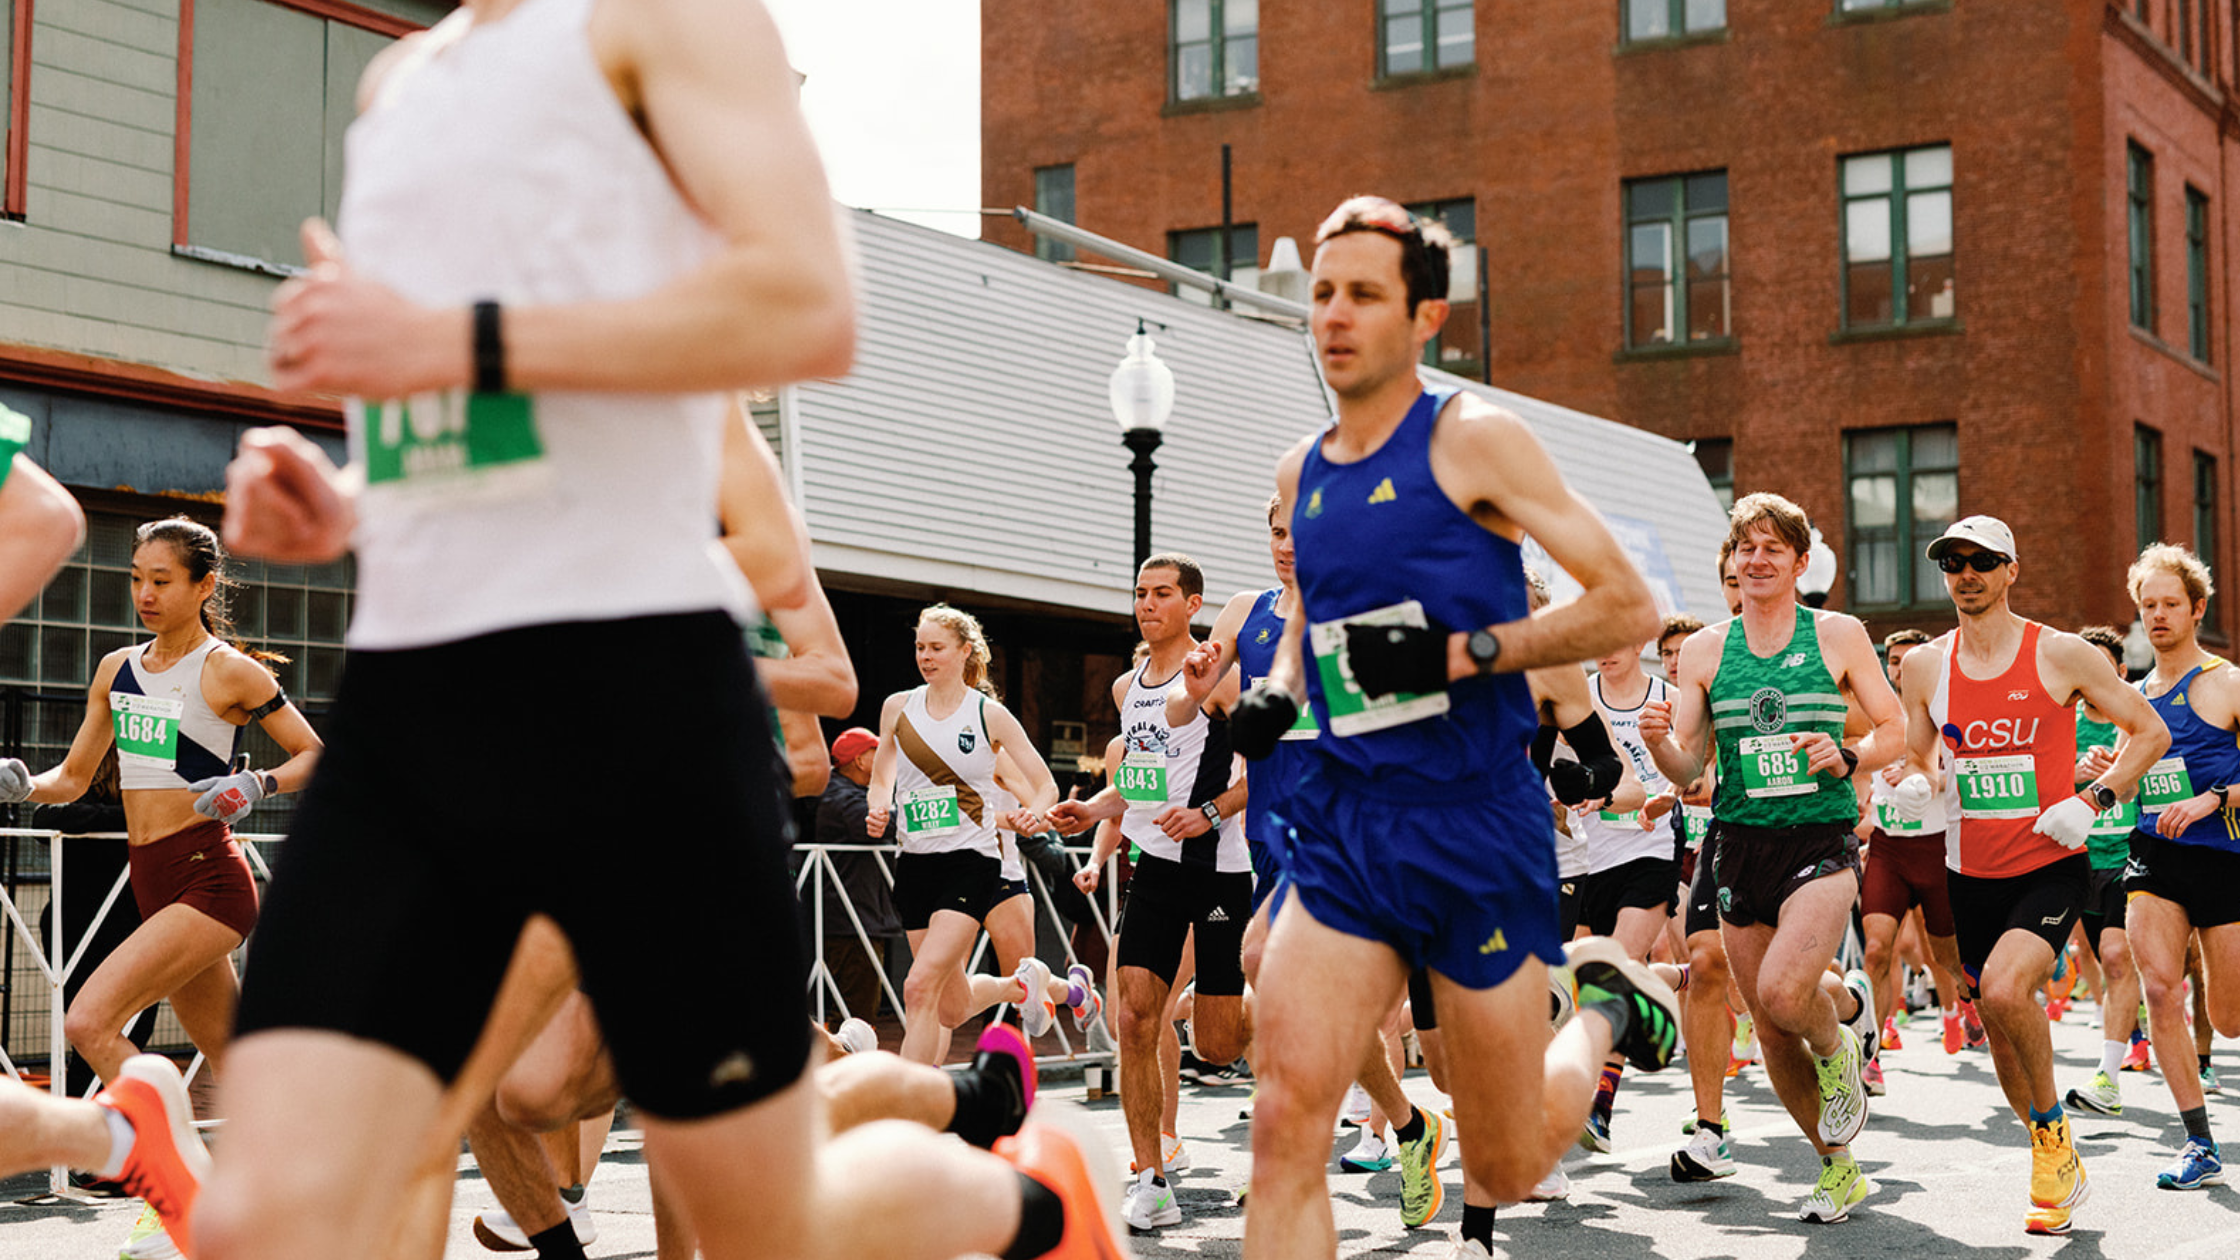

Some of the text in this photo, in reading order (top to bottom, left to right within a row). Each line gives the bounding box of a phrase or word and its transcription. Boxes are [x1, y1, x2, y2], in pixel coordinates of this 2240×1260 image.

[118, 713, 167, 745] 1684
[1964, 717, 2039, 749] CSU
[1757, 751, 1799, 777] 685
[1119, 767, 1158, 790] 1843
[1766, 775, 1794, 787] AARON
[1967, 773, 2025, 799] 1910
[2143, 773, 2182, 796] 1596
[910, 799, 951, 823] 1282
[2095, 803, 2123, 820] 20
[1688, 817, 1708, 835] 98
